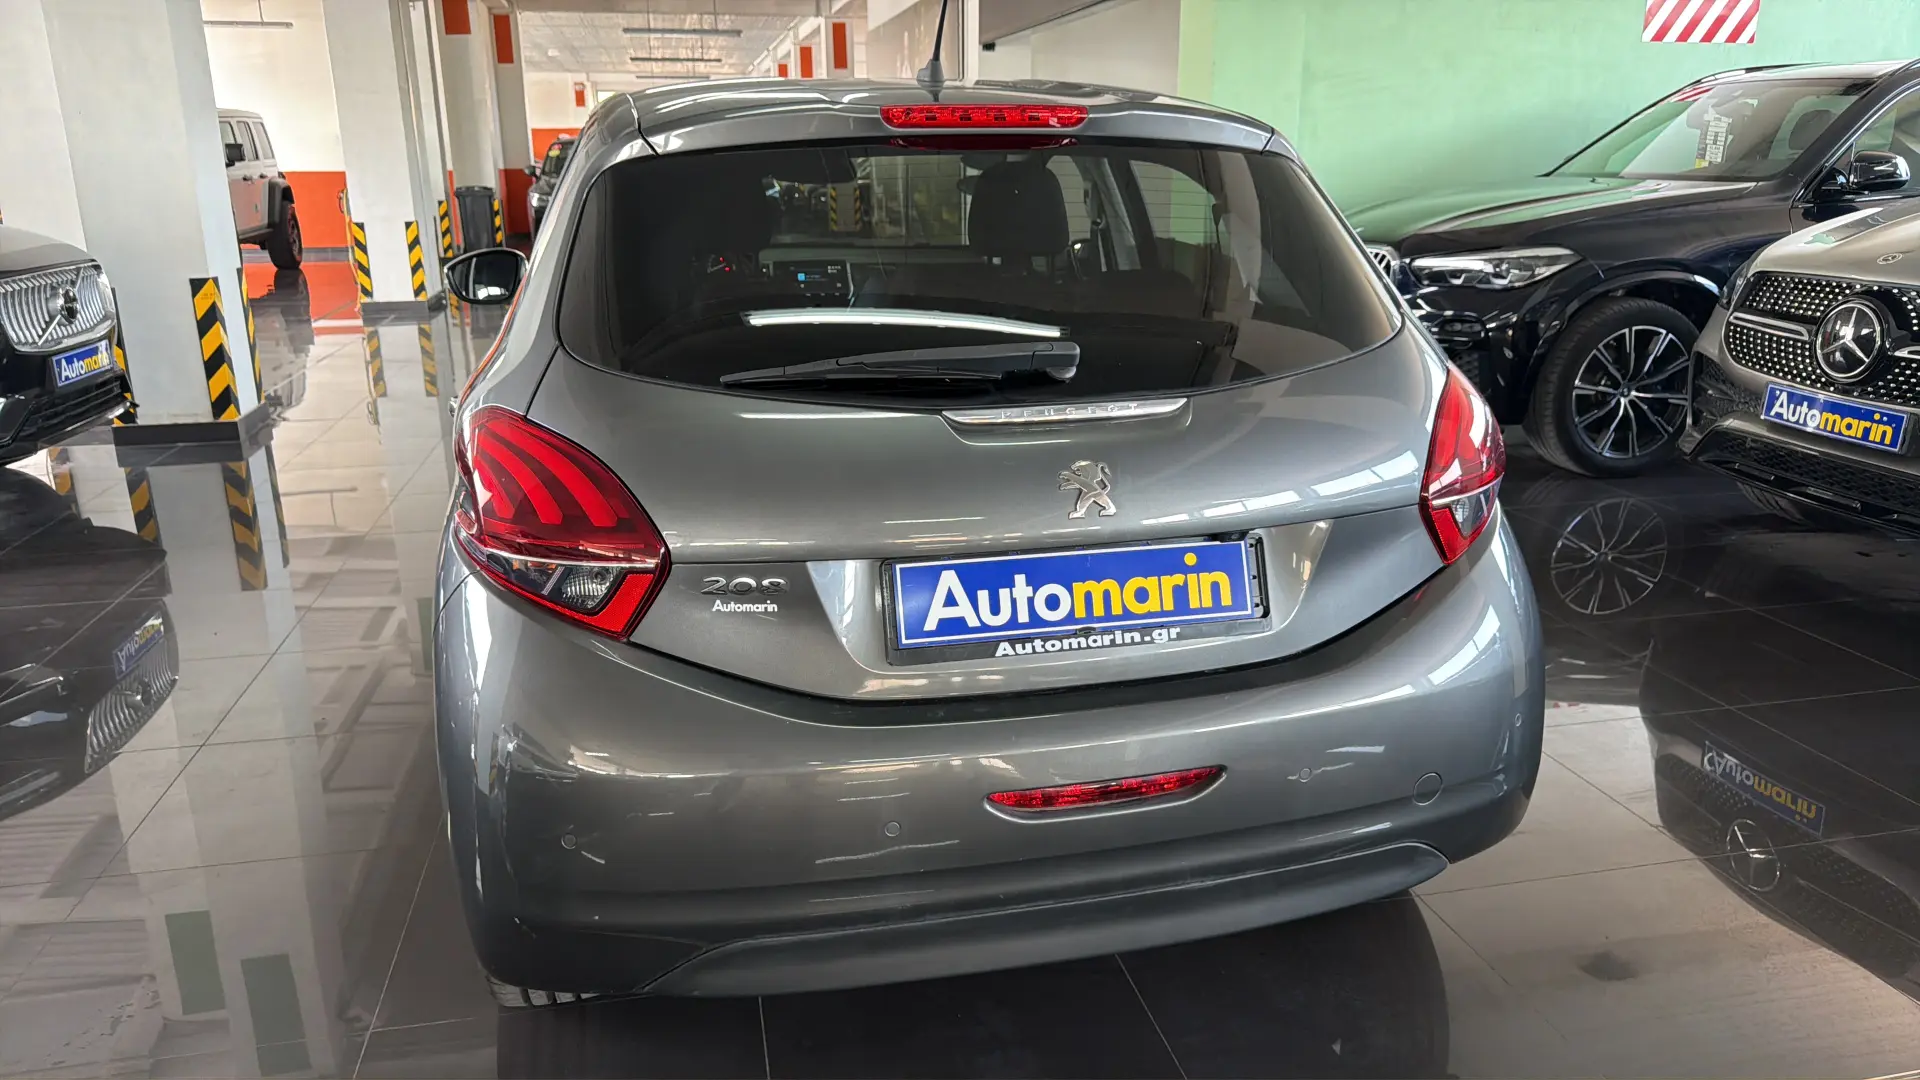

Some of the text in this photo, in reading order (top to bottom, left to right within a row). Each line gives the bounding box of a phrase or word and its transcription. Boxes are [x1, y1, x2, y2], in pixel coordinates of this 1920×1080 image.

[1001, 402, 1139, 420] PEUGEOT
[1769, 391, 1894, 445] Automarin
[700, 576, 787, 596] 208
[923, 552, 1232, 632] Automarin
[711, 599, 778, 612] Automarin
[995, 625, 1181, 657] Automarin.gr
